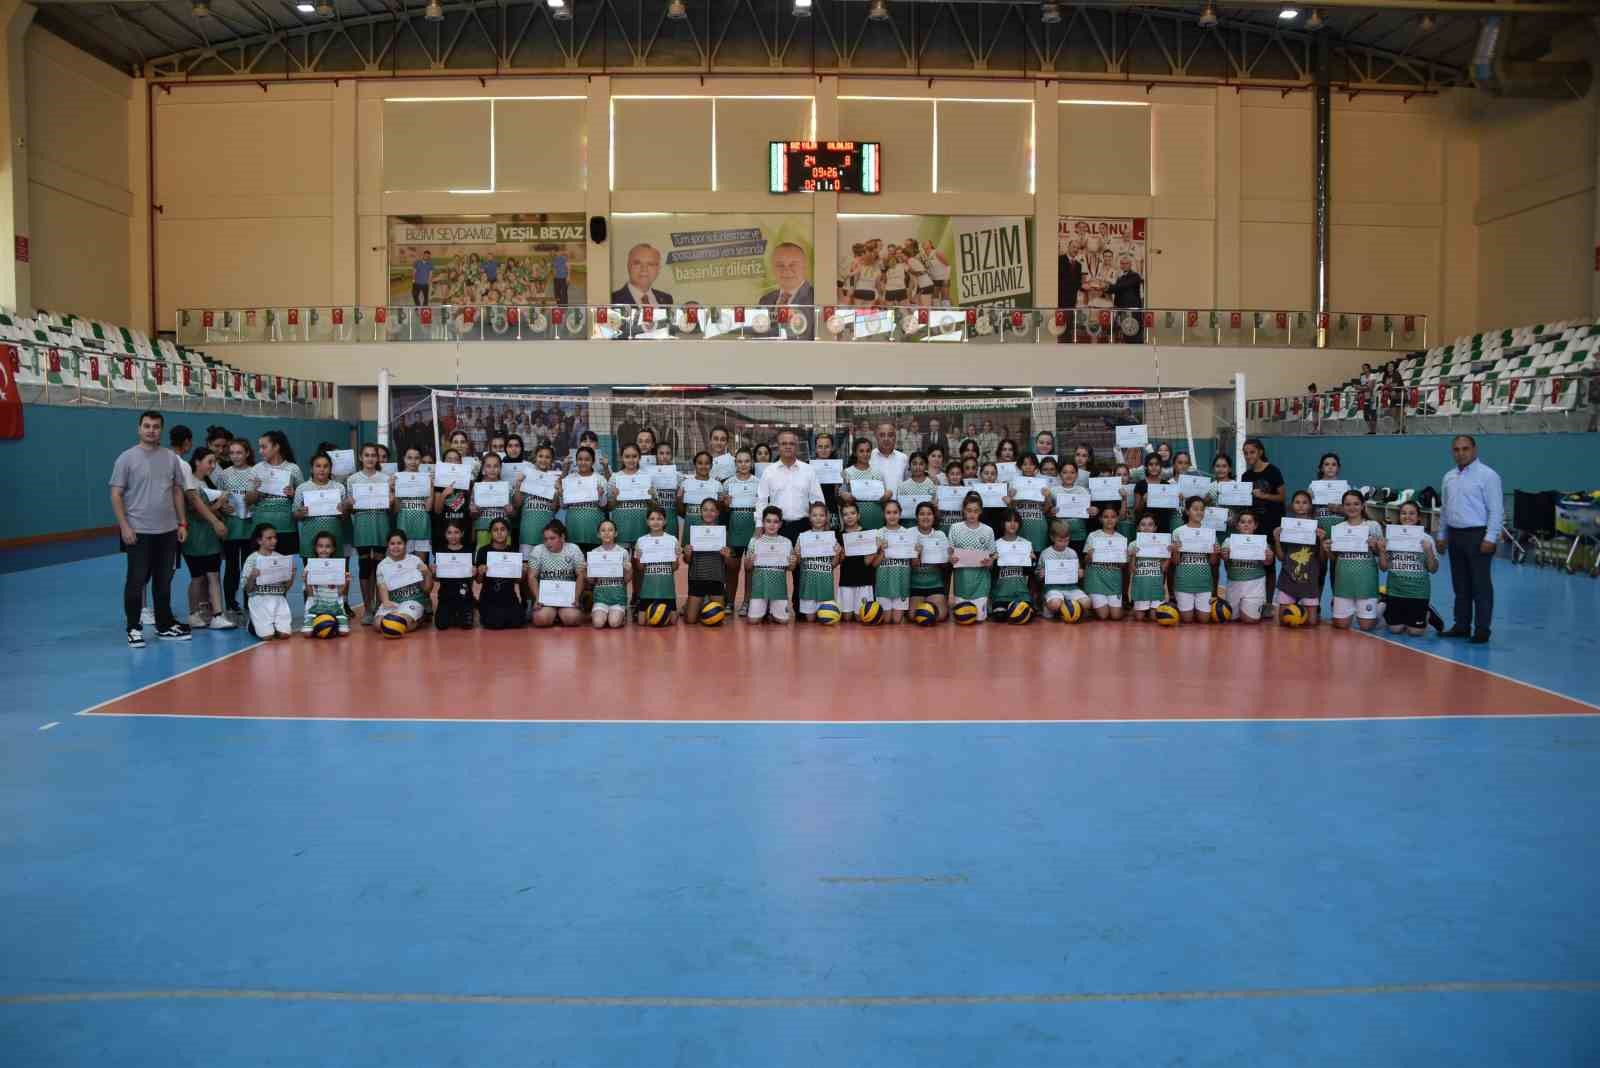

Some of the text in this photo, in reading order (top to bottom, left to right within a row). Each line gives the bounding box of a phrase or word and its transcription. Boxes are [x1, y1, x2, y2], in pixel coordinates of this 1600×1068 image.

[812, 167, 837, 178] 09:26
[540, 226, 584, 240] BEYAZ
[962, 266, 1025, 298] SEVDAMIZ
